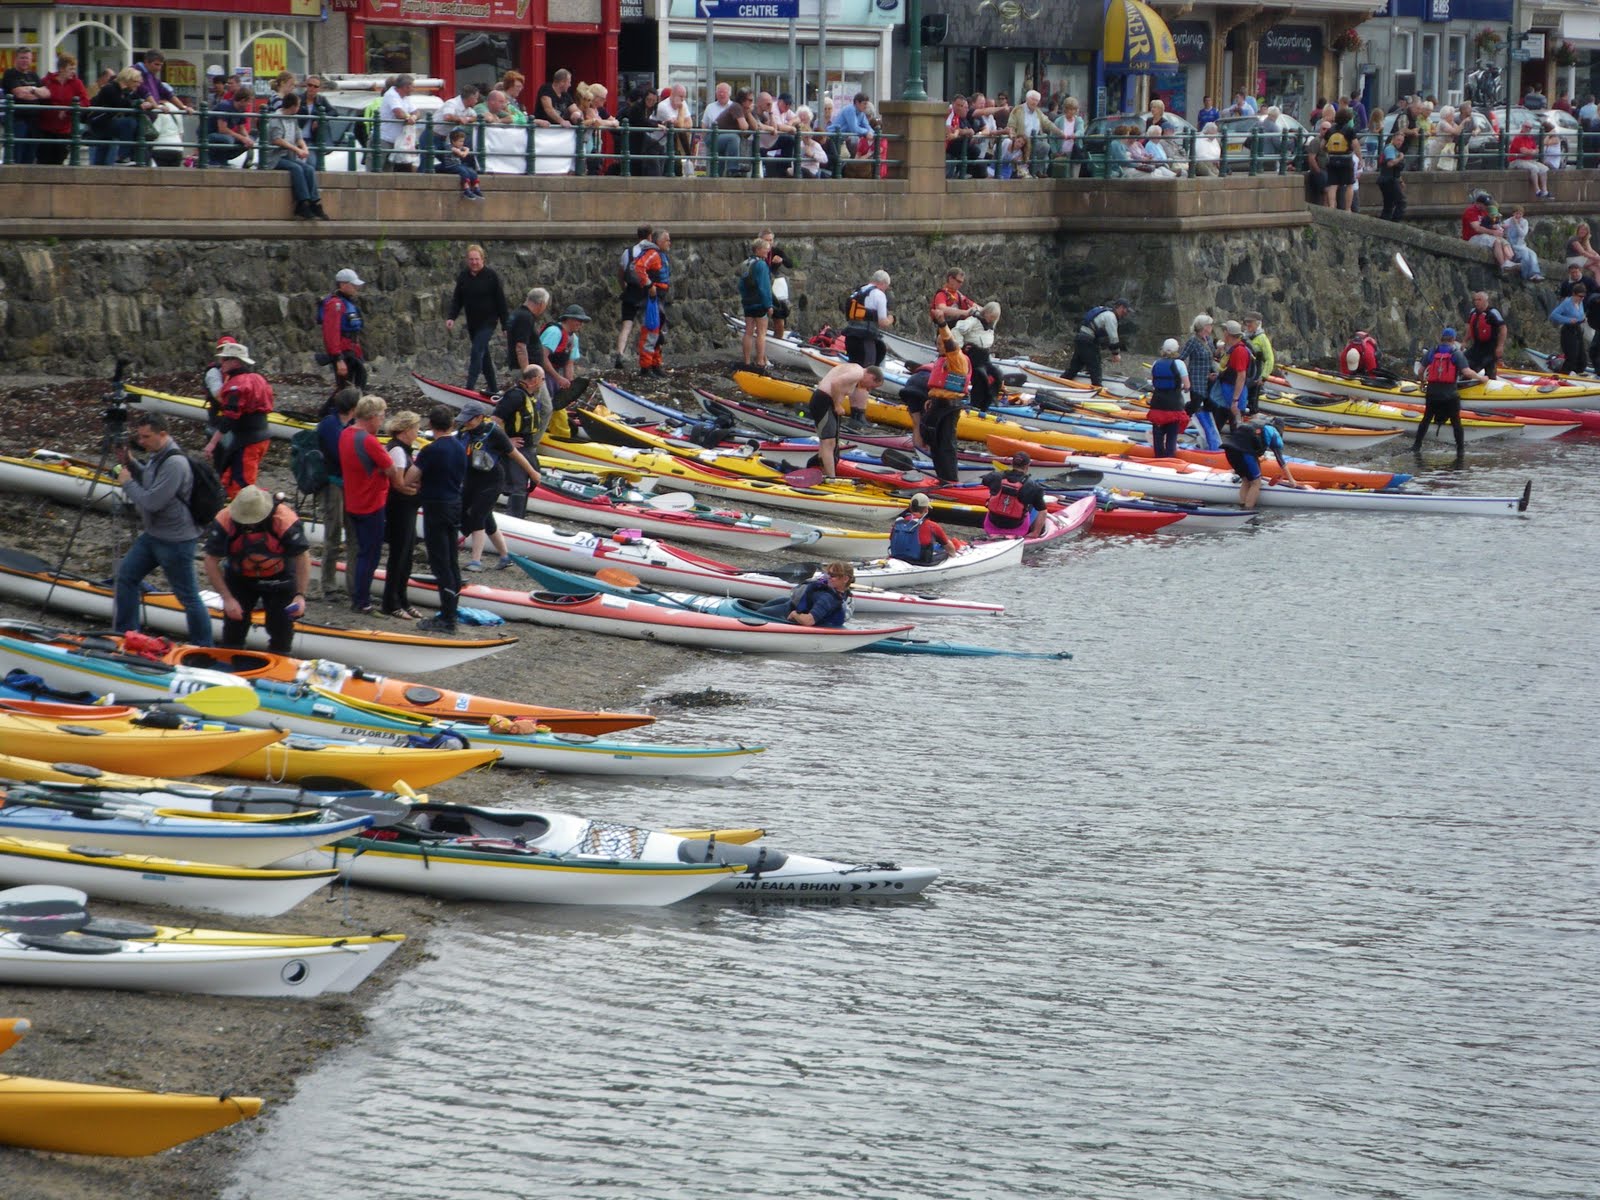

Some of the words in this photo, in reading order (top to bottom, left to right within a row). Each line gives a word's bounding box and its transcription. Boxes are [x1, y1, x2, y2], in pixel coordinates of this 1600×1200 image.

[738, 4, 779, 17] CENTRE
[1266, 30, 1312, 53] Superdrug
[255, 43, 285, 72] FINAL
[168, 66, 196, 84] FINA
[575, 533, 596, 548] 26
[341, 726, 396, 741] EXPLORER
[735, 881, 757, 890] AN
[761, 881, 795, 891] EALA
[799, 882, 841, 892] BHAN
